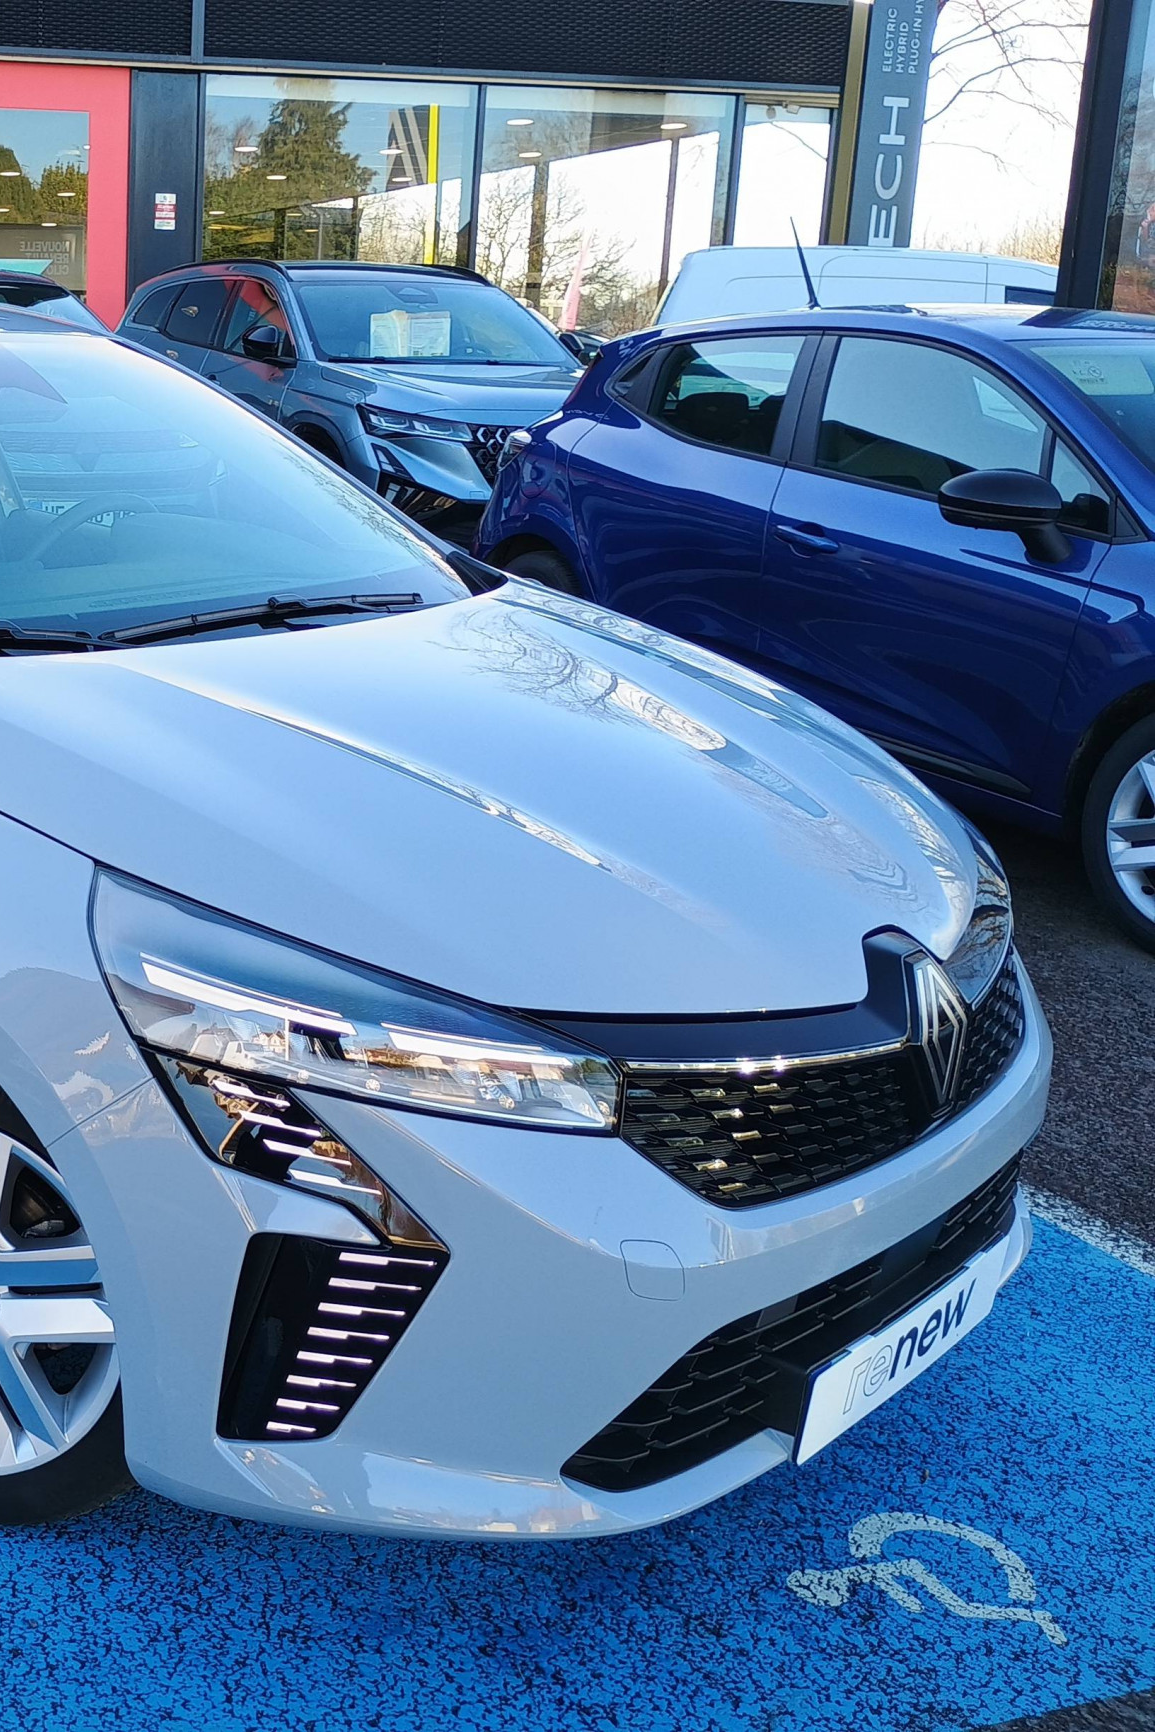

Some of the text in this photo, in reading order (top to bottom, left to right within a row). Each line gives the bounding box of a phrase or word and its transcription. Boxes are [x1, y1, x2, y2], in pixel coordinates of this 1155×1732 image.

[882, 8, 898, 72] ELECTRIC
[895, 22, 909, 73] HYBRID
[908, 18, 923, 74] PLUG-IN
[868, 96, 910, 247] ECH
[843, 1277, 978, 1415] renew
